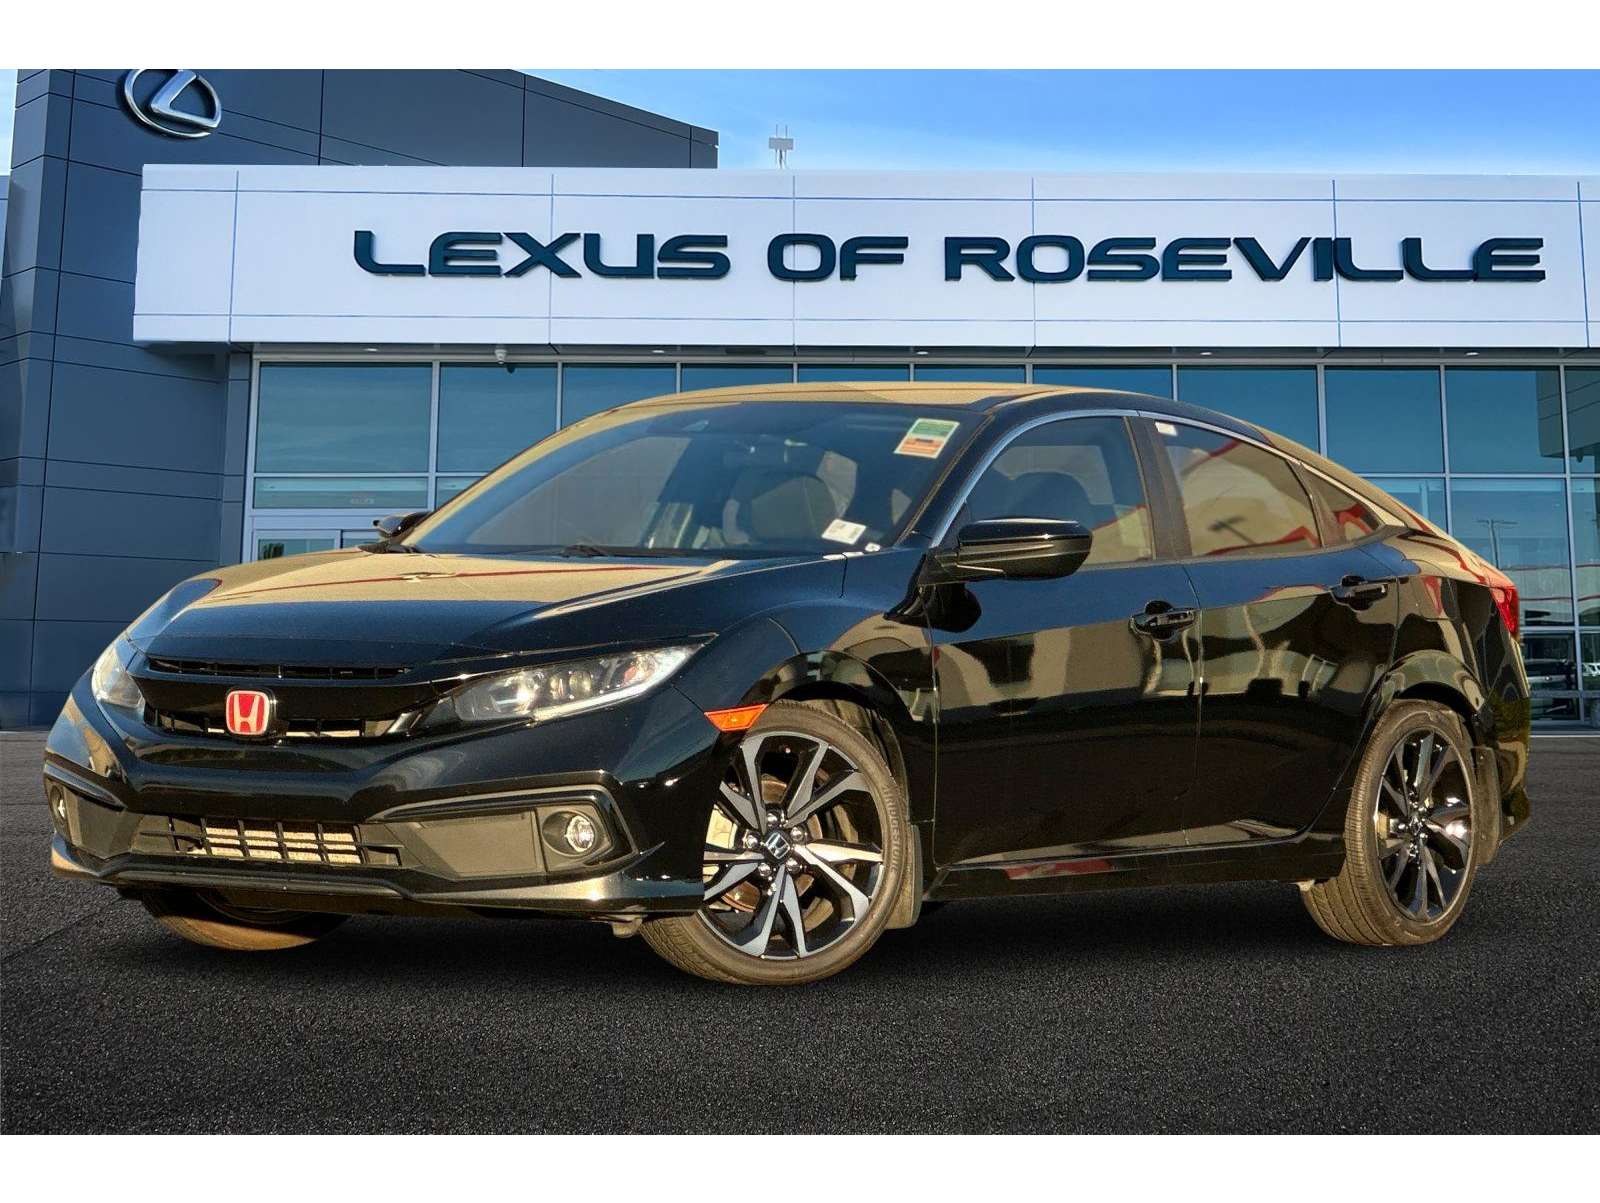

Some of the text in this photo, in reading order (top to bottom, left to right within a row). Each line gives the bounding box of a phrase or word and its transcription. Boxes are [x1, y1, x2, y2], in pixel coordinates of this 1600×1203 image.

[353, 230, 1547, 285] LEXUS OF ROSEVILLE
